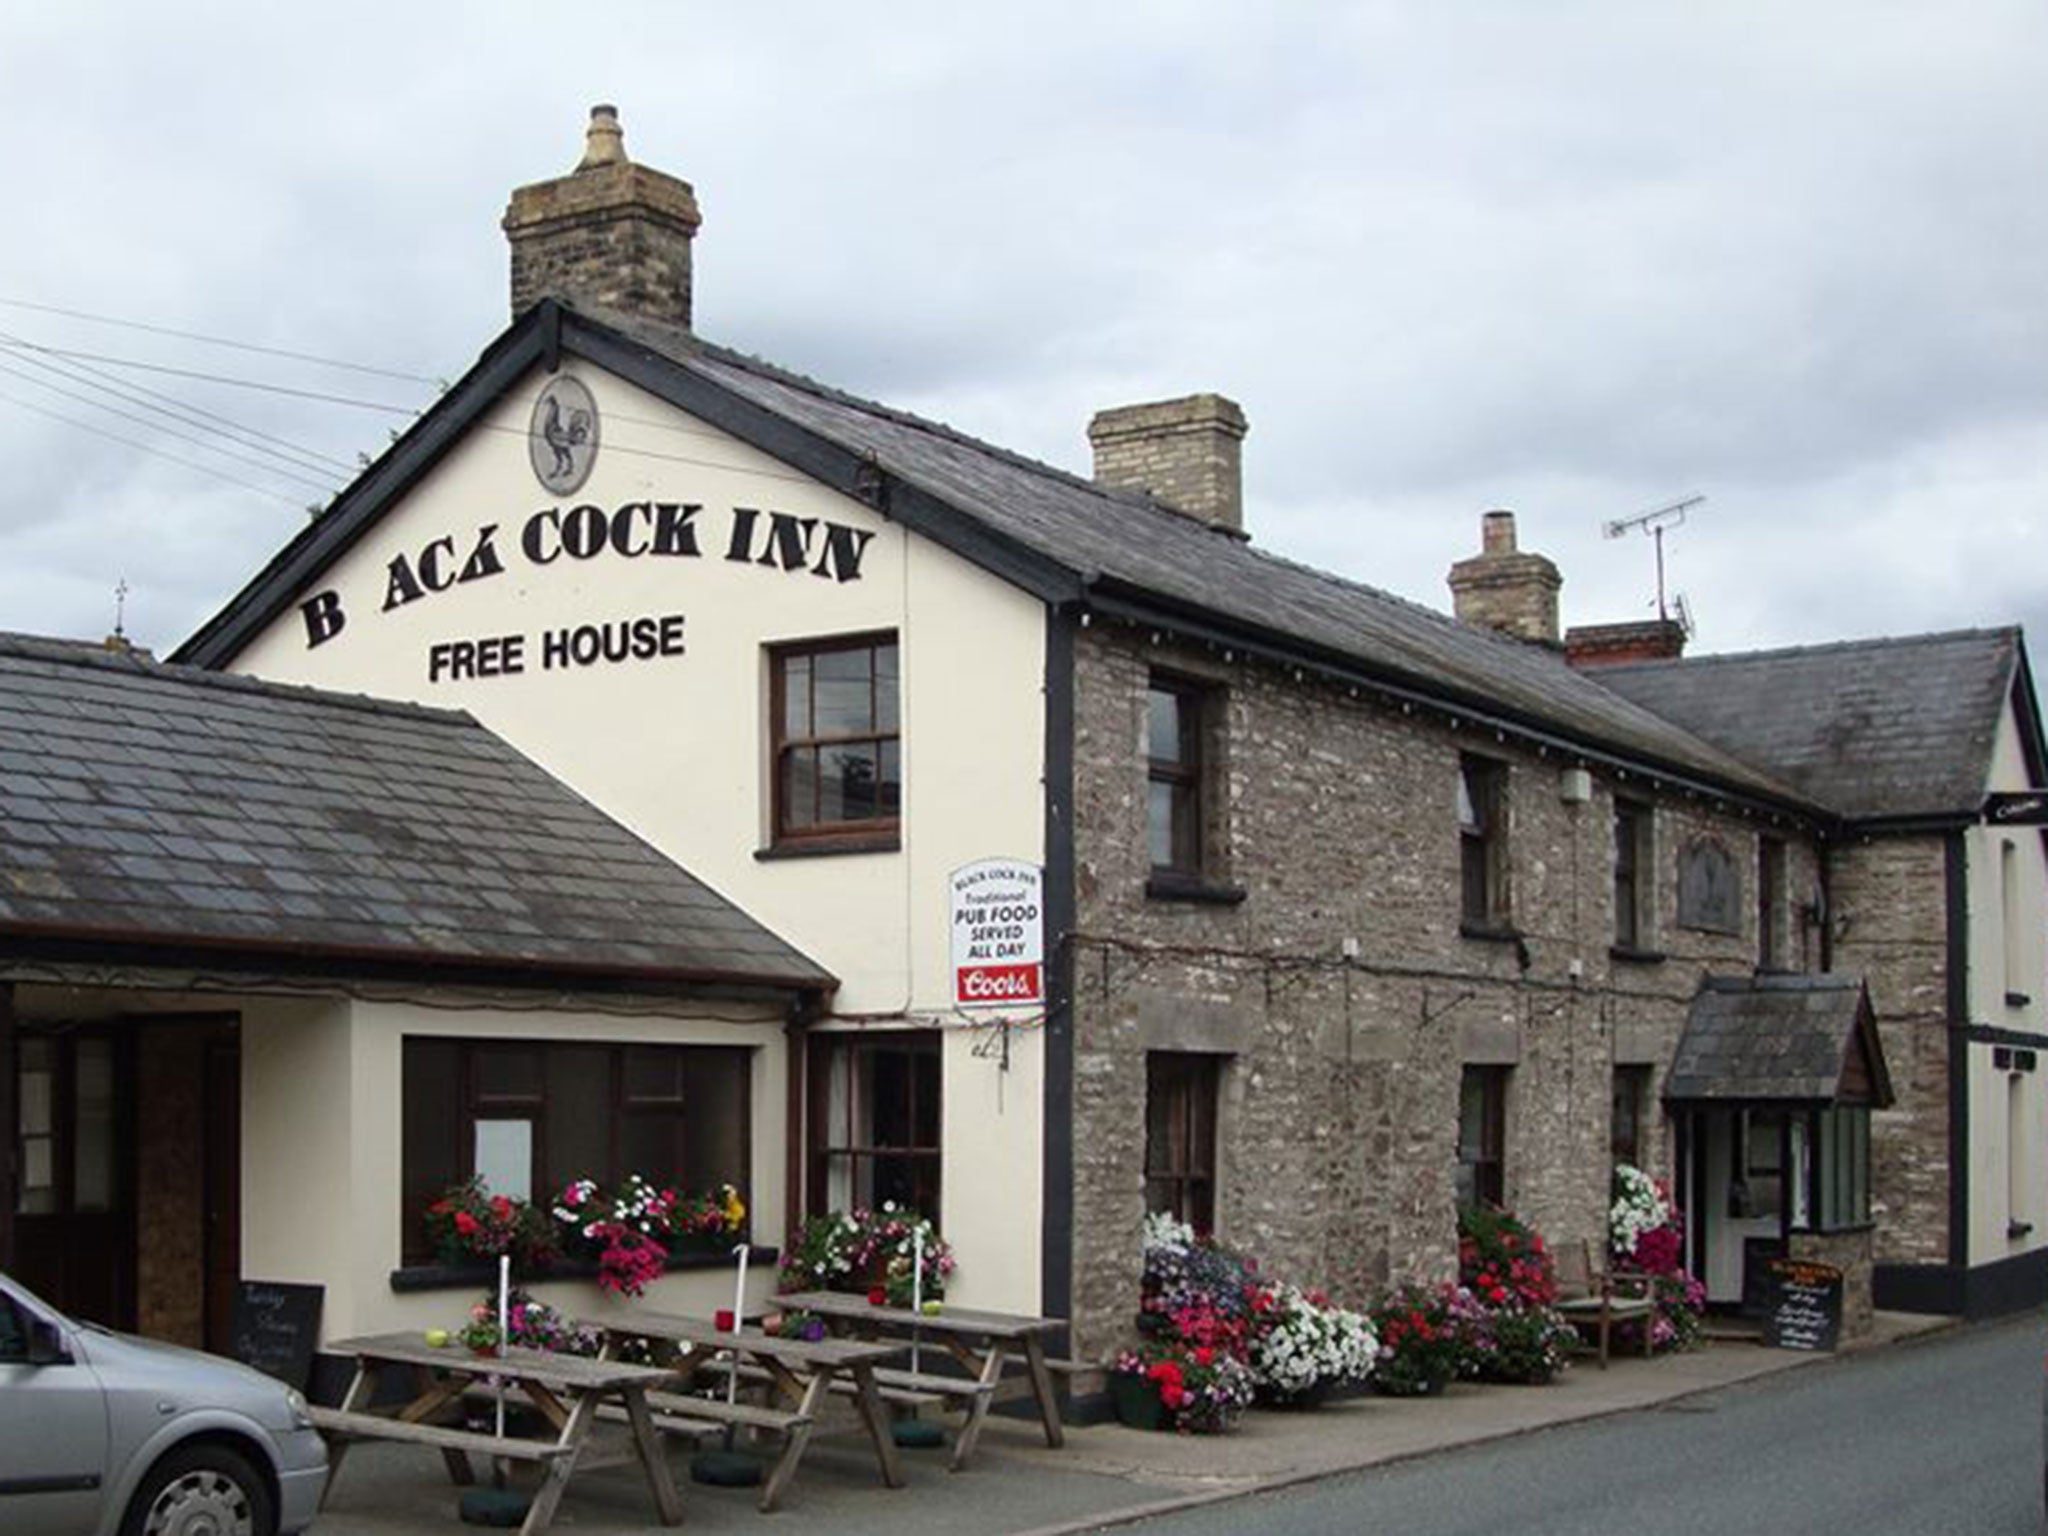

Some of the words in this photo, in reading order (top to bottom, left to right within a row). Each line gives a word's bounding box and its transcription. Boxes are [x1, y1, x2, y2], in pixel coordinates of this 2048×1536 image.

[301, 523, 505, 650] BACK
[521, 502, 703, 566] COCK
[724, 507, 876, 583] INN
[428, 635, 524, 683] FREE
[542, 615, 685, 670] HOUSE
[955, 873, 985, 891] BLACK
[988, 868, 1016, 881] COCK
[965, 889, 1027, 904] Traditional
[955, 908, 987, 925] PUB
[991, 905, 1038, 922] FOOD
[971, 925, 1023, 941] SERVED
[968, 945, 992, 958] ALL
[996, 943, 1025, 958] DAY
[964, 970, 1031, 996] Coors
